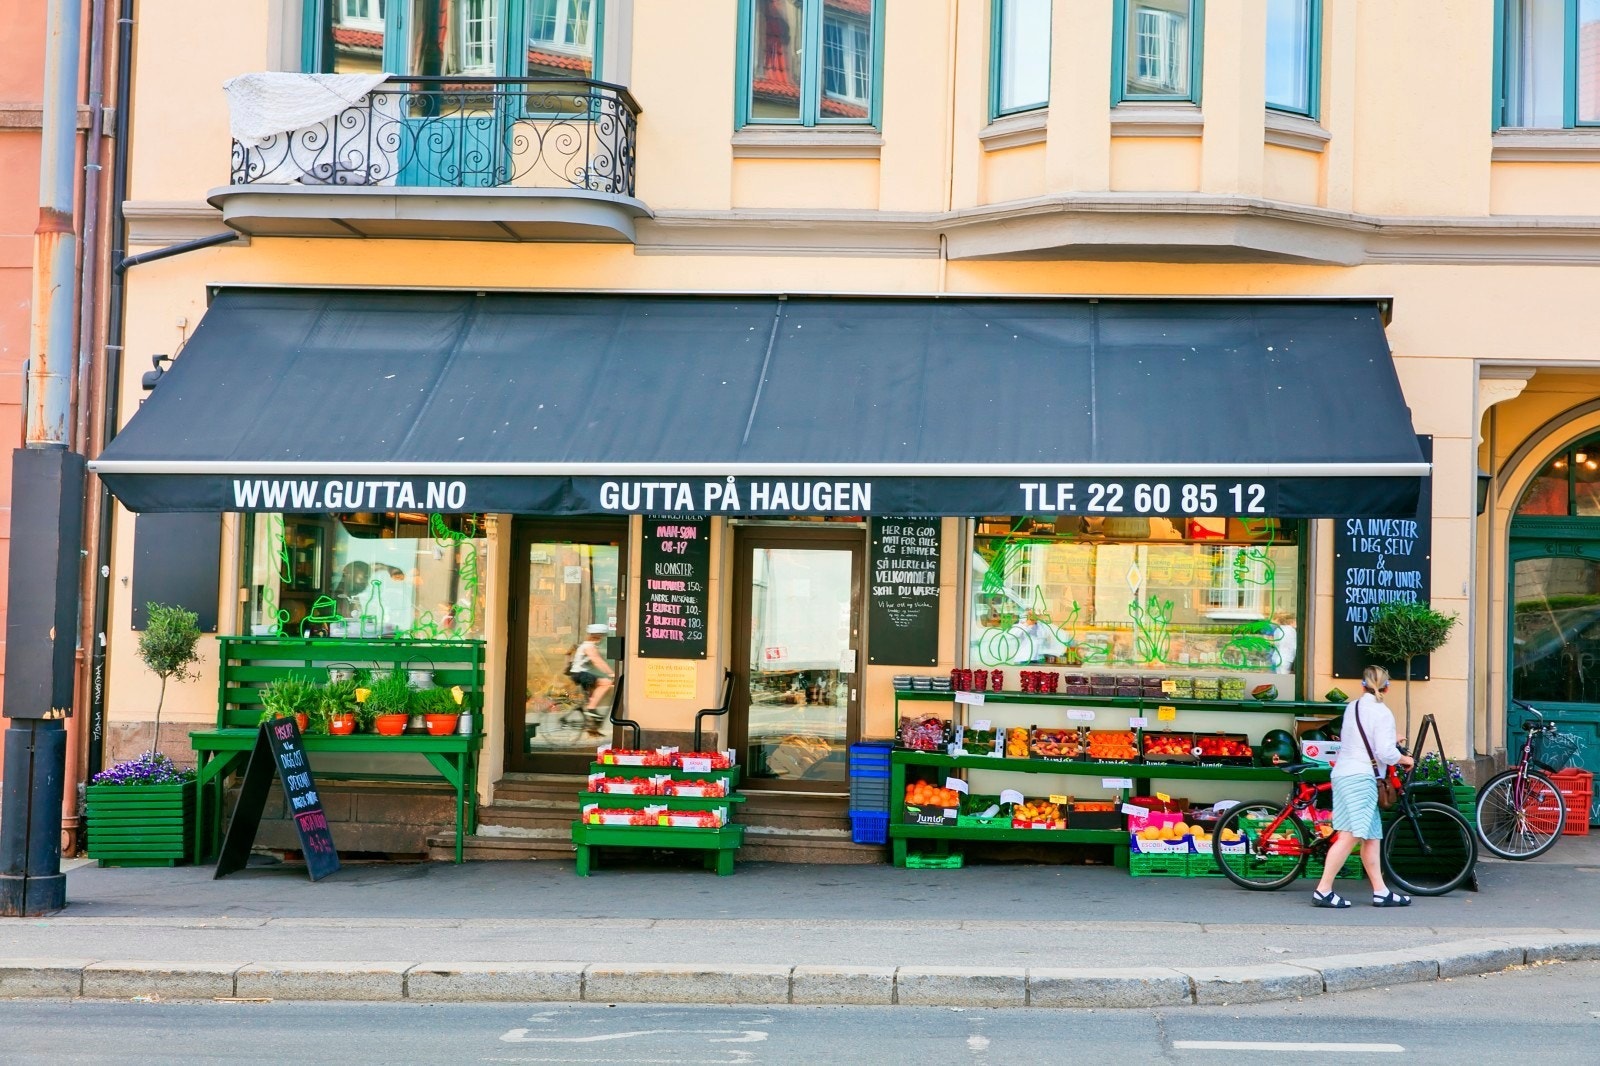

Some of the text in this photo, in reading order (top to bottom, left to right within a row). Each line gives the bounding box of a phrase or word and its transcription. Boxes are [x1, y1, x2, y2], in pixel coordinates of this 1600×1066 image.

[233, 480, 467, 509] WWW.GUTTA.NO
[599, 475, 872, 510] GUTTA PÅ HAUGEN
[1020, 483, 1266, 512] TLF. 22 60 85 12
[882, 525, 935, 537] HER ER GOD
[1368, 518, 1419, 538] INVESTER
[661, 540, 688, 554] 08-19
[882, 535, 899, 544] MAT
[901, 537, 916, 546] FOR
[1352, 537, 1414, 555] I DEG SELV
[883, 545, 896, 553] OG
[876, 557, 889, 569] SÅ
[1376, 553, 1385, 570] &
[655, 562, 694, 576] BLOMSTER:
[875, 570, 935, 584] VELKOMMEN
[1346, 567, 1423, 589] STØTT OPP UNDER
[650, 593, 669, 603] ANDRE
[873, 586, 940, 596] SKAL DU VÆRE!
[1345, 587, 1417, 605] SPESIALBUTIKKER
[645, 602, 651, 612] 1
[652, 603, 682, 614] BUKETT
[1345, 606, 1368, 623] MED
[645, 614, 651, 624] 2
[653, 615, 687, 628] BUKETTER
[645, 626, 651, 638] 3
[652, 628, 685, 641] BUKETTER
[916, 813, 946, 823] Junior
